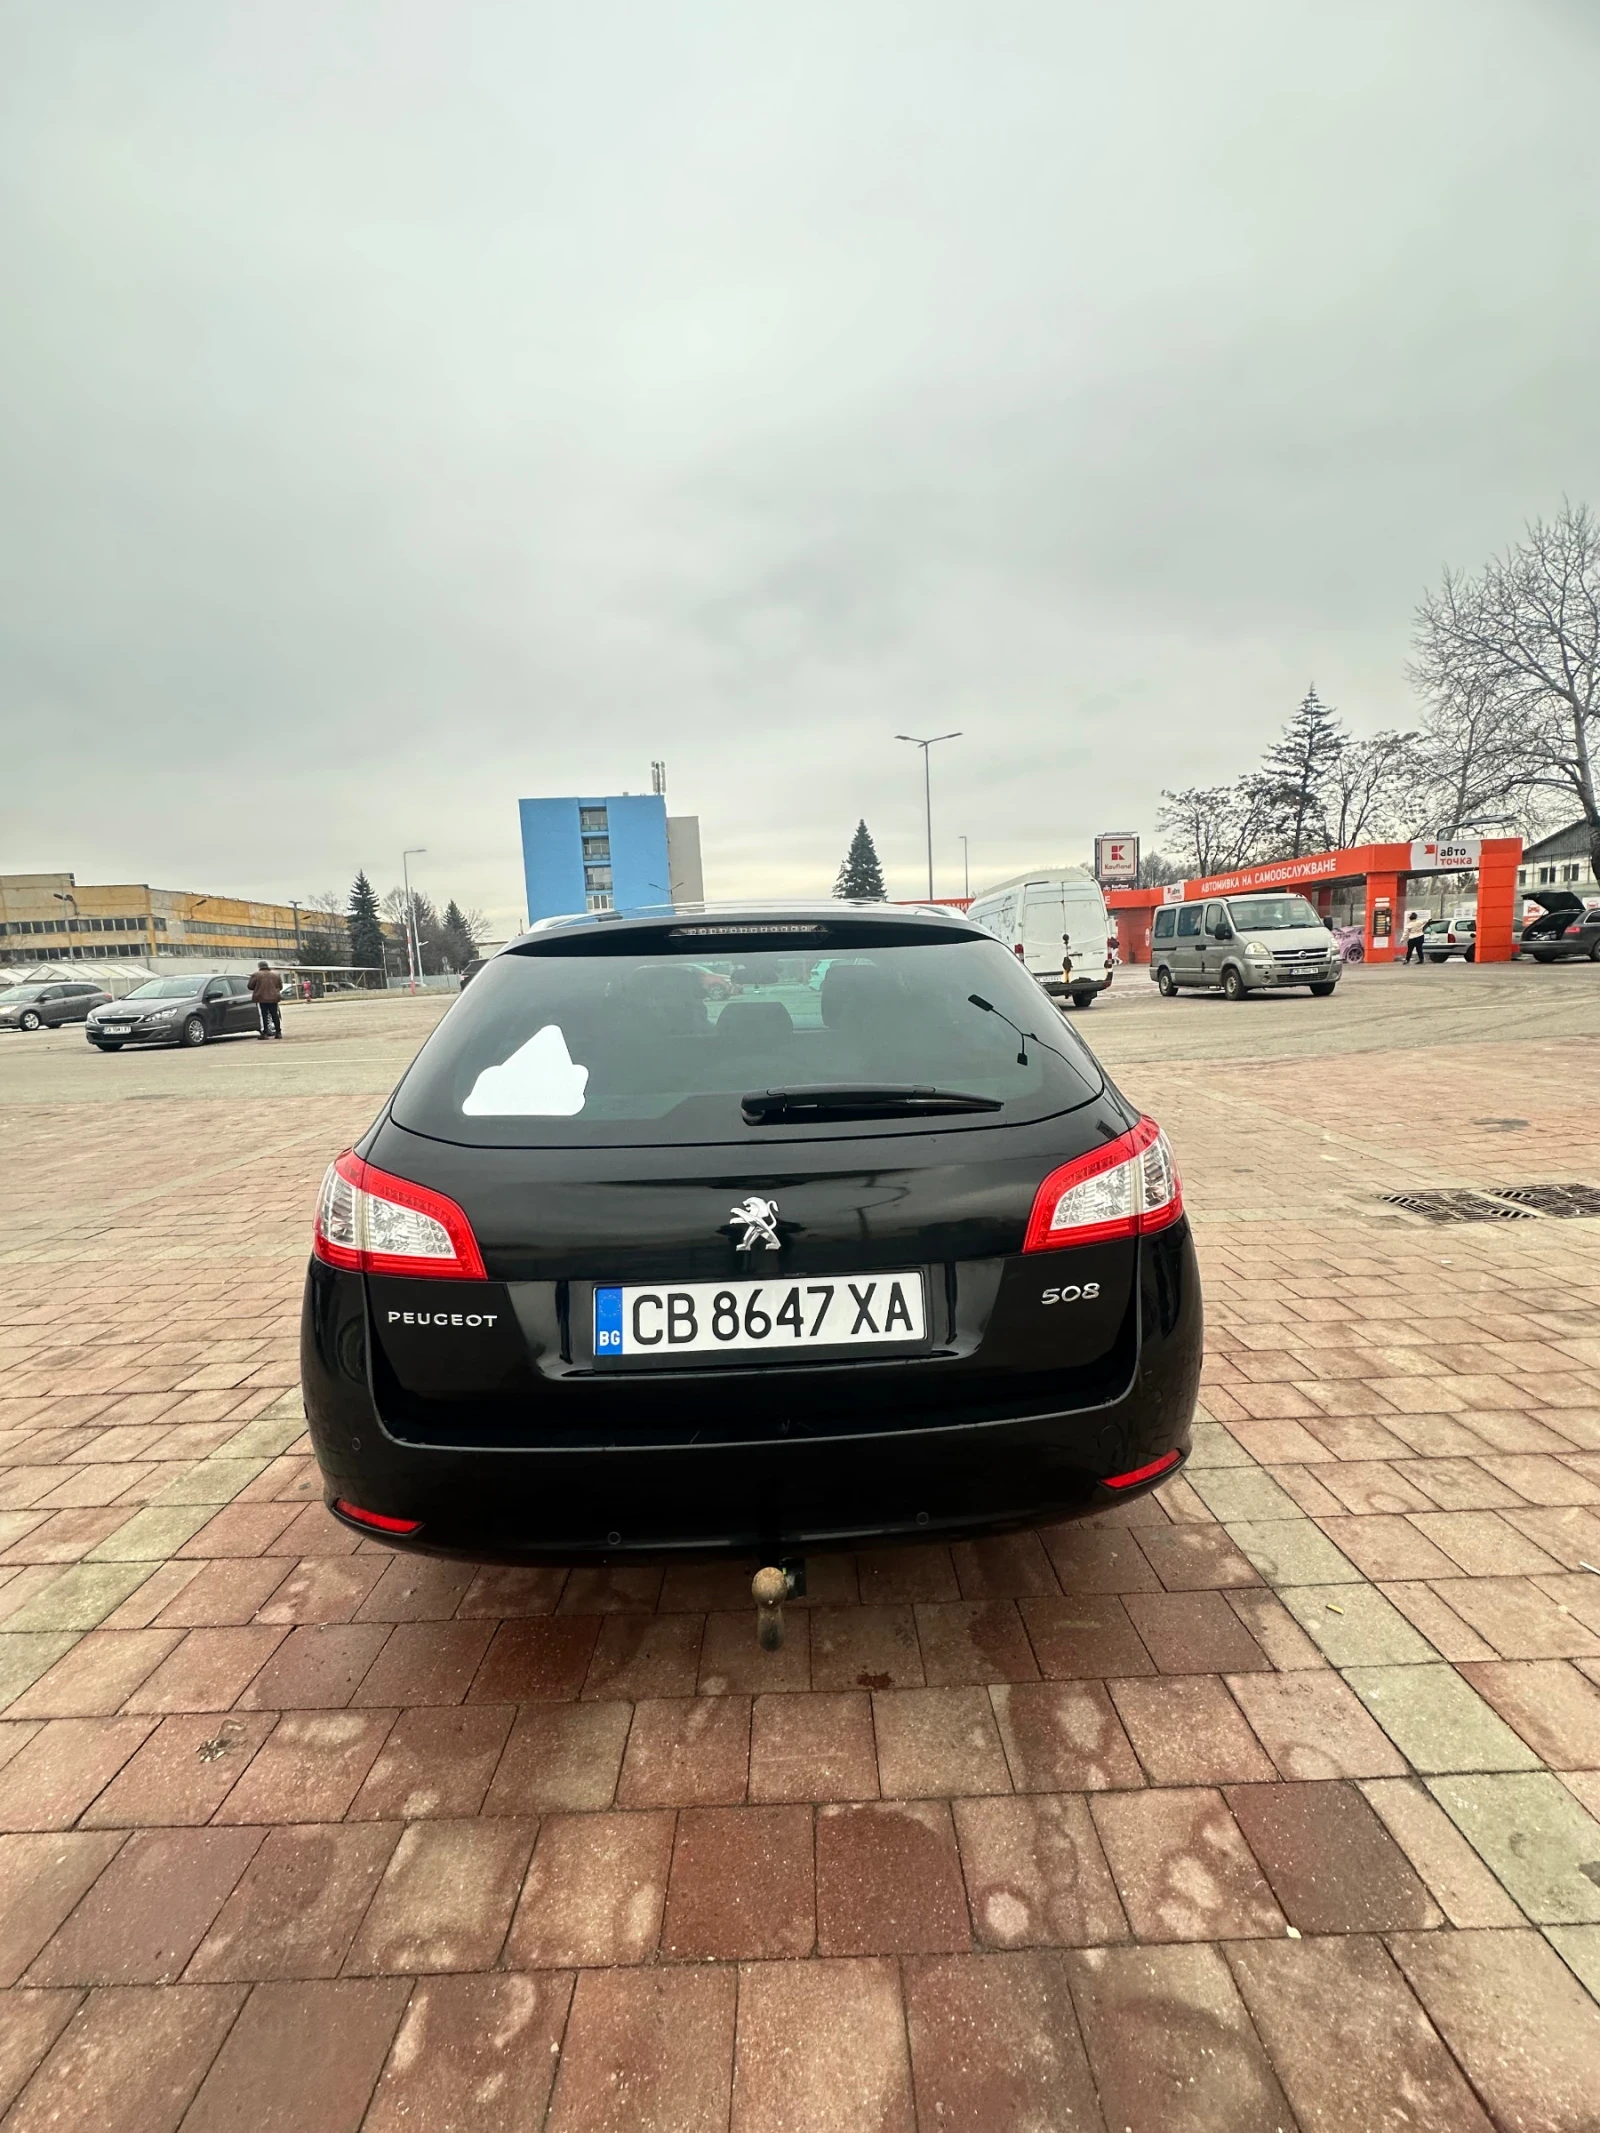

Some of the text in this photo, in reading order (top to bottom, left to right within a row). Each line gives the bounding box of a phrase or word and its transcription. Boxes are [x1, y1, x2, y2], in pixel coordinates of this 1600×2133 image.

[1440, 846, 1467, 857] авто
[1440, 857, 1472, 866] точка
[1201, 858, 1337, 893] АВТОМИВКА НА САМООБСЛУЖВАНЕ
[1040, 1282, 1101, 1305] 508
[388, 1311, 498, 1327] PEUGEOT
[599, 1282, 914, 1347] BG CB 8647 XA
